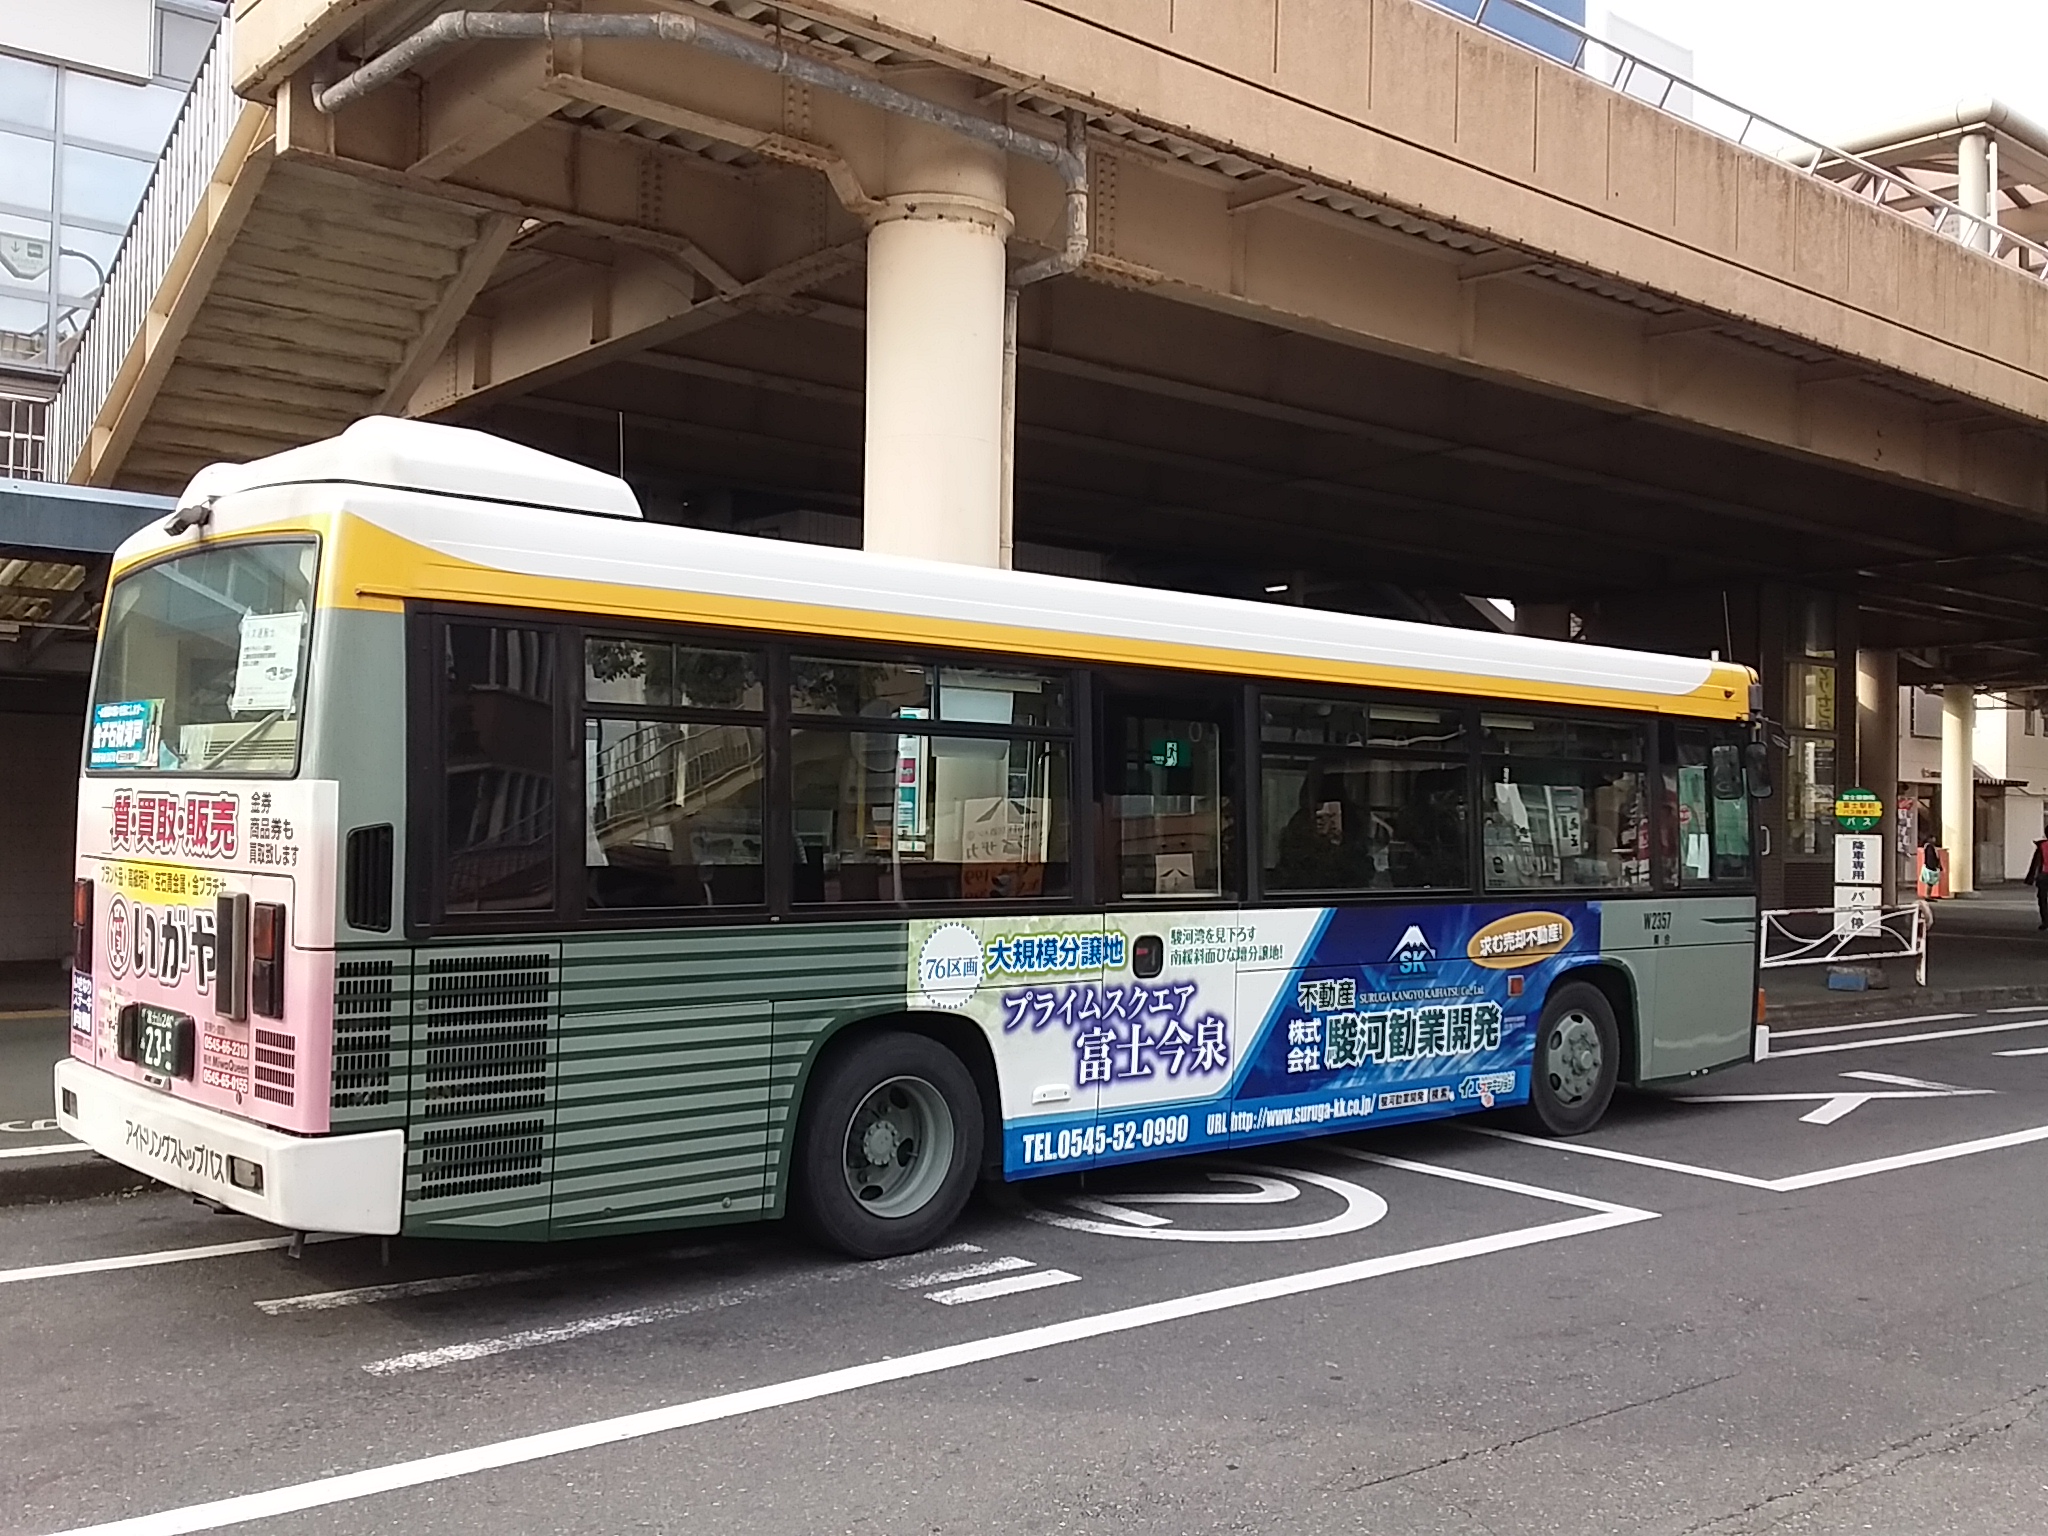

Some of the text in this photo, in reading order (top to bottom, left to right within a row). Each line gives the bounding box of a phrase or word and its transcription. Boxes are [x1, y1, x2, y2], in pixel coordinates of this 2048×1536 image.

[1852, 840, 1866, 881] 降車専用
[1643, 911, 1672, 930] W2357
[1851, 890, 1866, 930] バ停
[988, 934, 1124, 972] 大規模分譲地
[1170, 925, 1257, 946] 駿河湾を見下ろす
[926, 955, 979, 980] 76区画
[1399, 949, 1428, 974] SK
[1005, 983, 1196, 1029] プライムスクエア
[1297, 978, 1356, 1013] 不動産
[1359, 991, 1391, 1004] SURUGA
[1391, 989, 1425, 1003] KANGYO
[1424, 986, 1459, 1000] KAIHATSU
[1076, 1016, 1228, 1084] 富士今泉
[1287, 1017, 1322, 1046] 株式
[1324, 1000, 1503, 1071] 駿河勧業開発
[1287, 1045, 1321, 1073] 会社
[1206, 1092, 1378, 1136] URL http://www.suruga-kk.co.jp/
[125, 1118, 226, 1185] アイドリングストップバス
[1022, 1113, 1190, 1164] TEL.0545-52-0990
